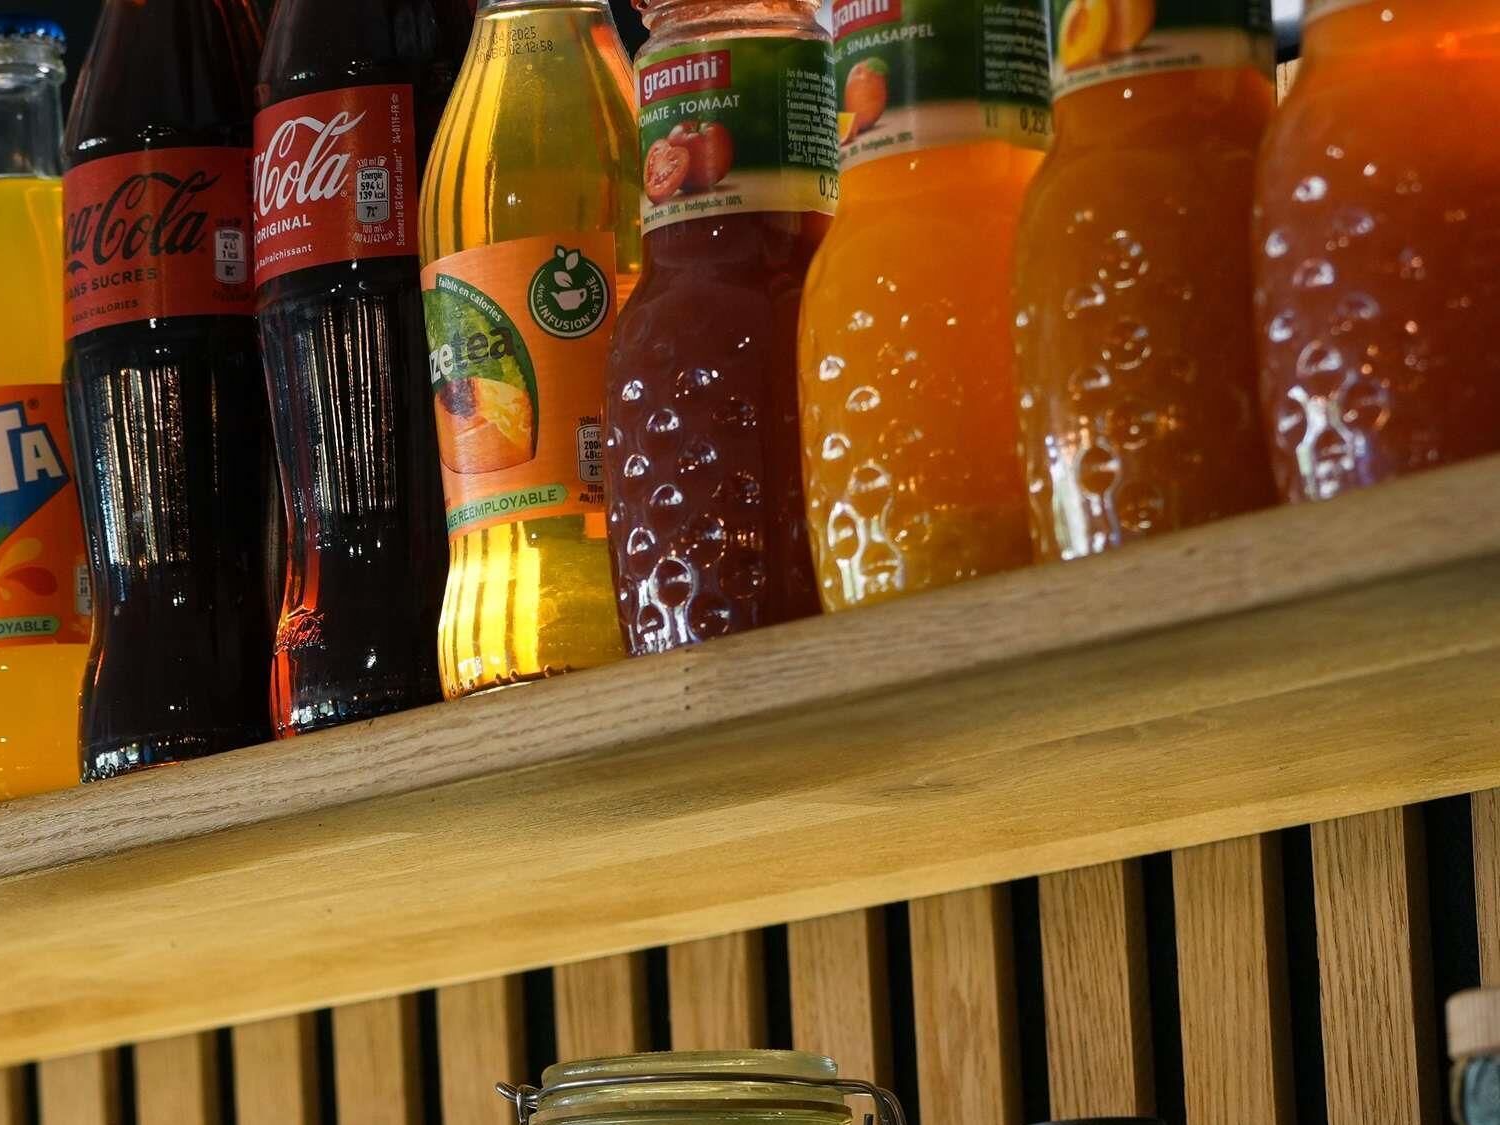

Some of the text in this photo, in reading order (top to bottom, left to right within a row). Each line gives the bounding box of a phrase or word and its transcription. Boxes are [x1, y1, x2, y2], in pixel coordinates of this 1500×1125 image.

[643, 55, 719, 100] granini
[679, 94, 740, 116] TOMAAT
[359, 191, 373, 200] 139
[360, 181, 375, 191] 594
[256, 213, 312, 244] ORIGINAL
[67, 267, 158, 300] ANS SUCRES
[536, 283, 546, 305] AVEC
[89, 299, 140, 318] CALORIES
[438, 276, 503, 323] faible en calories
